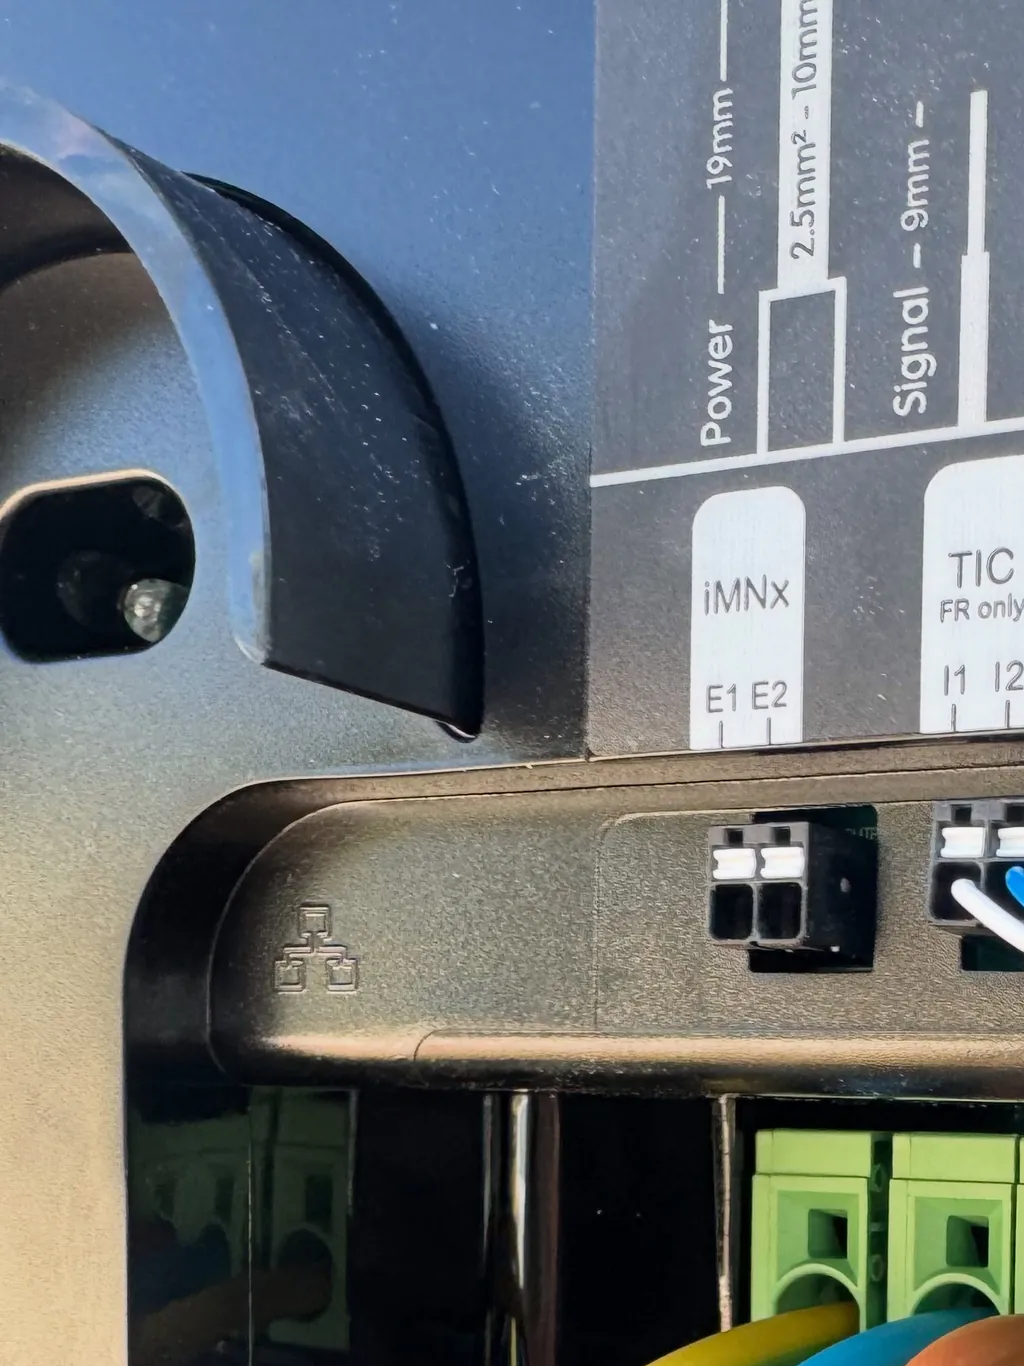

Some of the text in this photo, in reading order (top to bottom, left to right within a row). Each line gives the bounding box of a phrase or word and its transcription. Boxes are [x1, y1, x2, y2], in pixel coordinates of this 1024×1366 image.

[706, 87, 734, 190] 19mm
[901, 139, 931, 231] 9mm
[700, 320, 734, 447] Power
[893, 289, 937, 416] Signal
[940, 599, 970, 623] FR
[948, 547, 1014, 589] TIC
[706, 680, 787, 714] E1 E2
